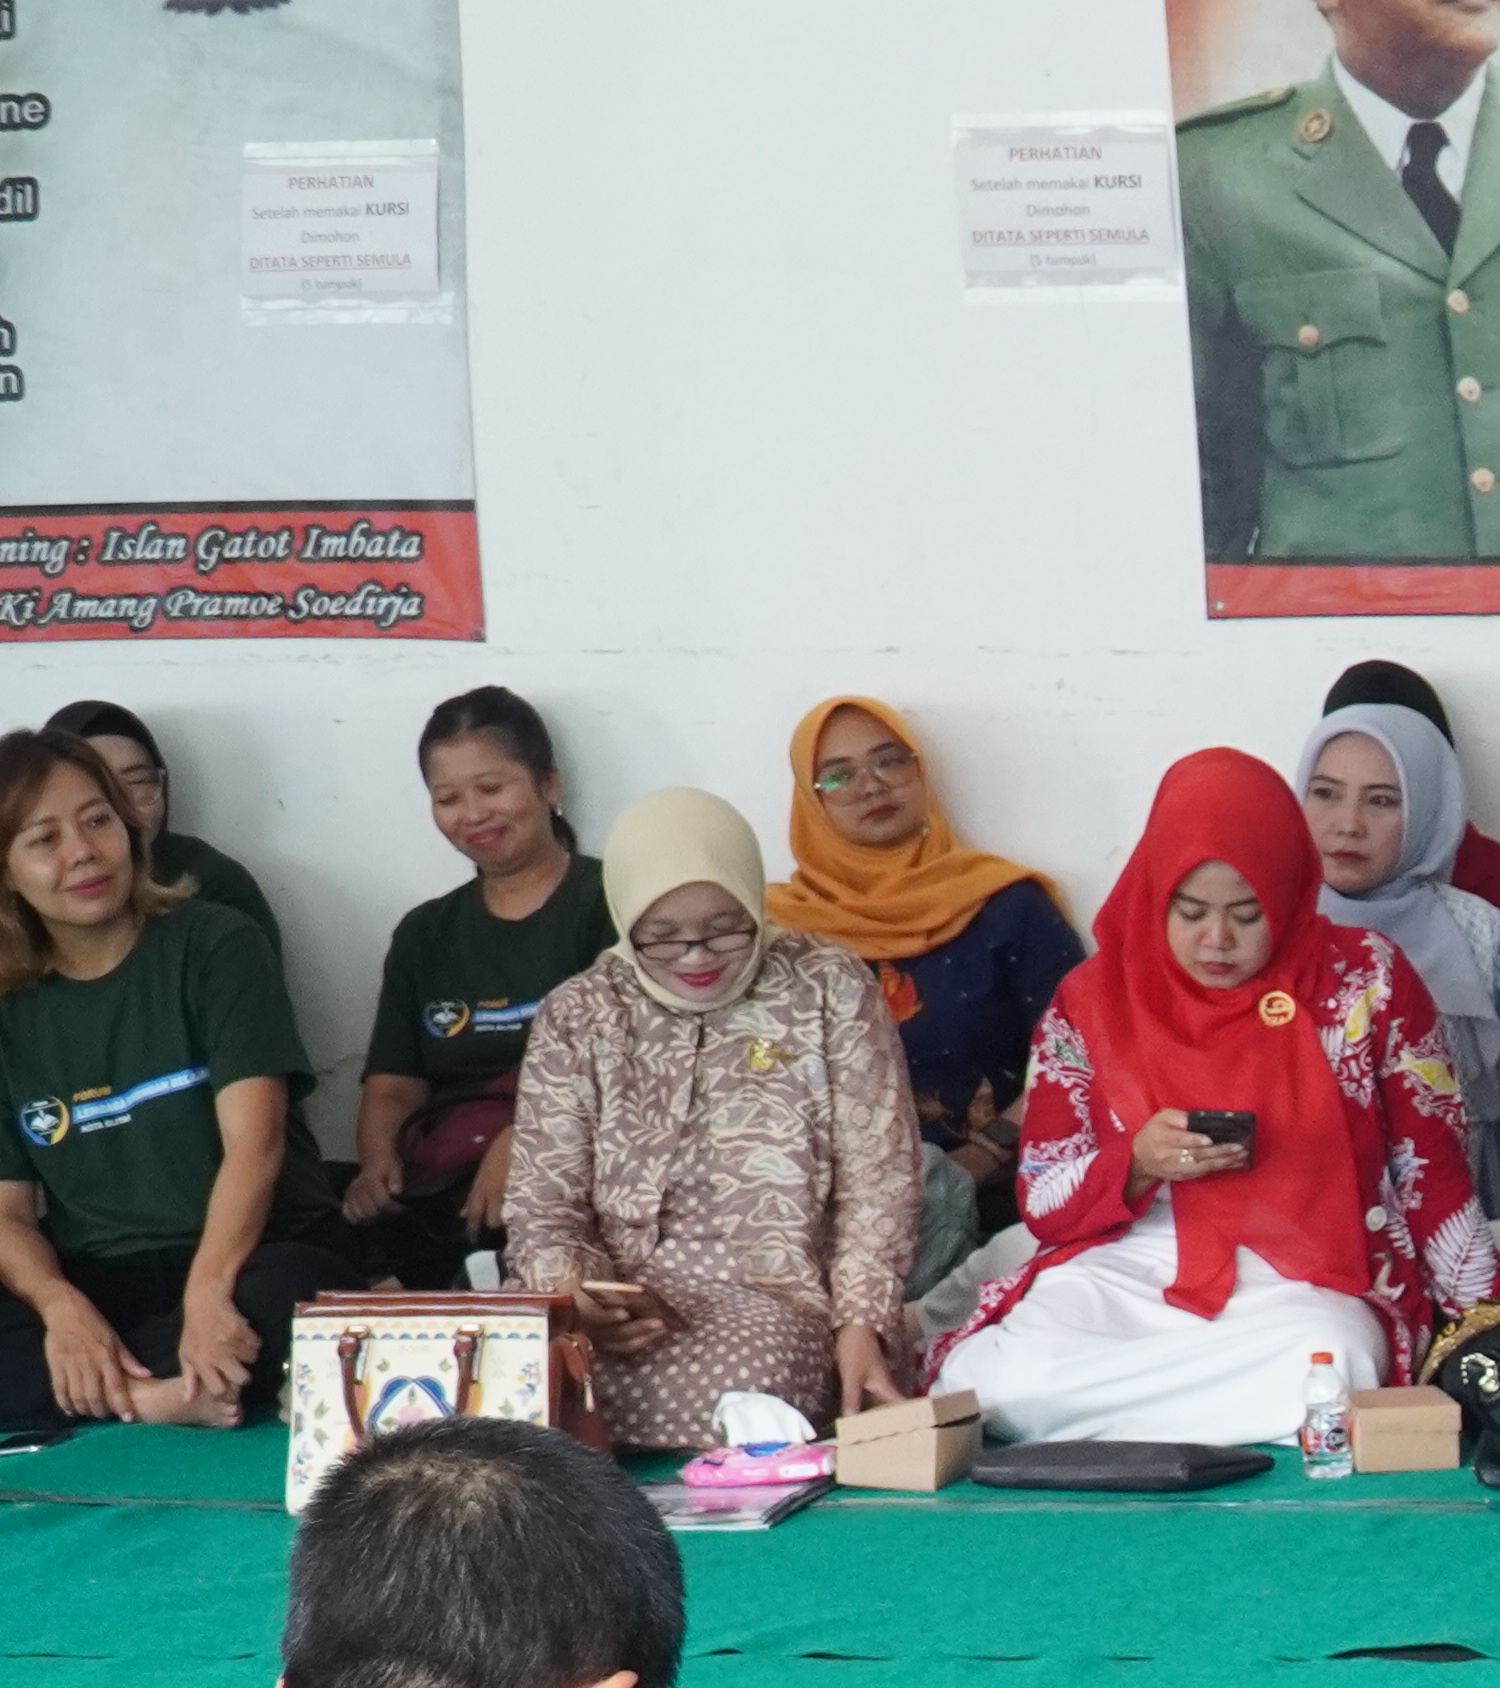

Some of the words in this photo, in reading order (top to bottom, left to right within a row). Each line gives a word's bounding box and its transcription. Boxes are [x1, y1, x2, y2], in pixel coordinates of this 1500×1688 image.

[1009, 146, 1102, 162] PERHATIAN
[288, 175, 375, 190] PERHATIAN
[970, 177, 1023, 192] Setelah
[1026, 175, 1090, 190] memakai
[1093, 174, 1142, 189] KURSI
[251, 206, 299, 220] Setelah
[303, 203, 361, 218] memakai
[365, 201, 409, 217] KURSI
[1026, 203, 1090, 218] Dimohon
[301, 230, 360, 244] Dimohon
[972, 229, 1027, 246] DITATA
[1030, 228, 1085, 244] SEPERTI
[1089, 227, 1150, 243] SEMULA
[250, 255, 298, 271] DITATA
[301, 254, 353, 270] SEPERTI
[356, 252, 411, 269] SEMULA
[101, 522, 187, 561] Islan
[197, 527, 291, 572] Gatot
[302, 521, 422, 561] Imbata
[0, 590, 40, 626] Ki
[37, 591, 157, 629] Amang
[166, 587, 283, 619] Pramoe
[288, 583, 422, 629] Soedirja
